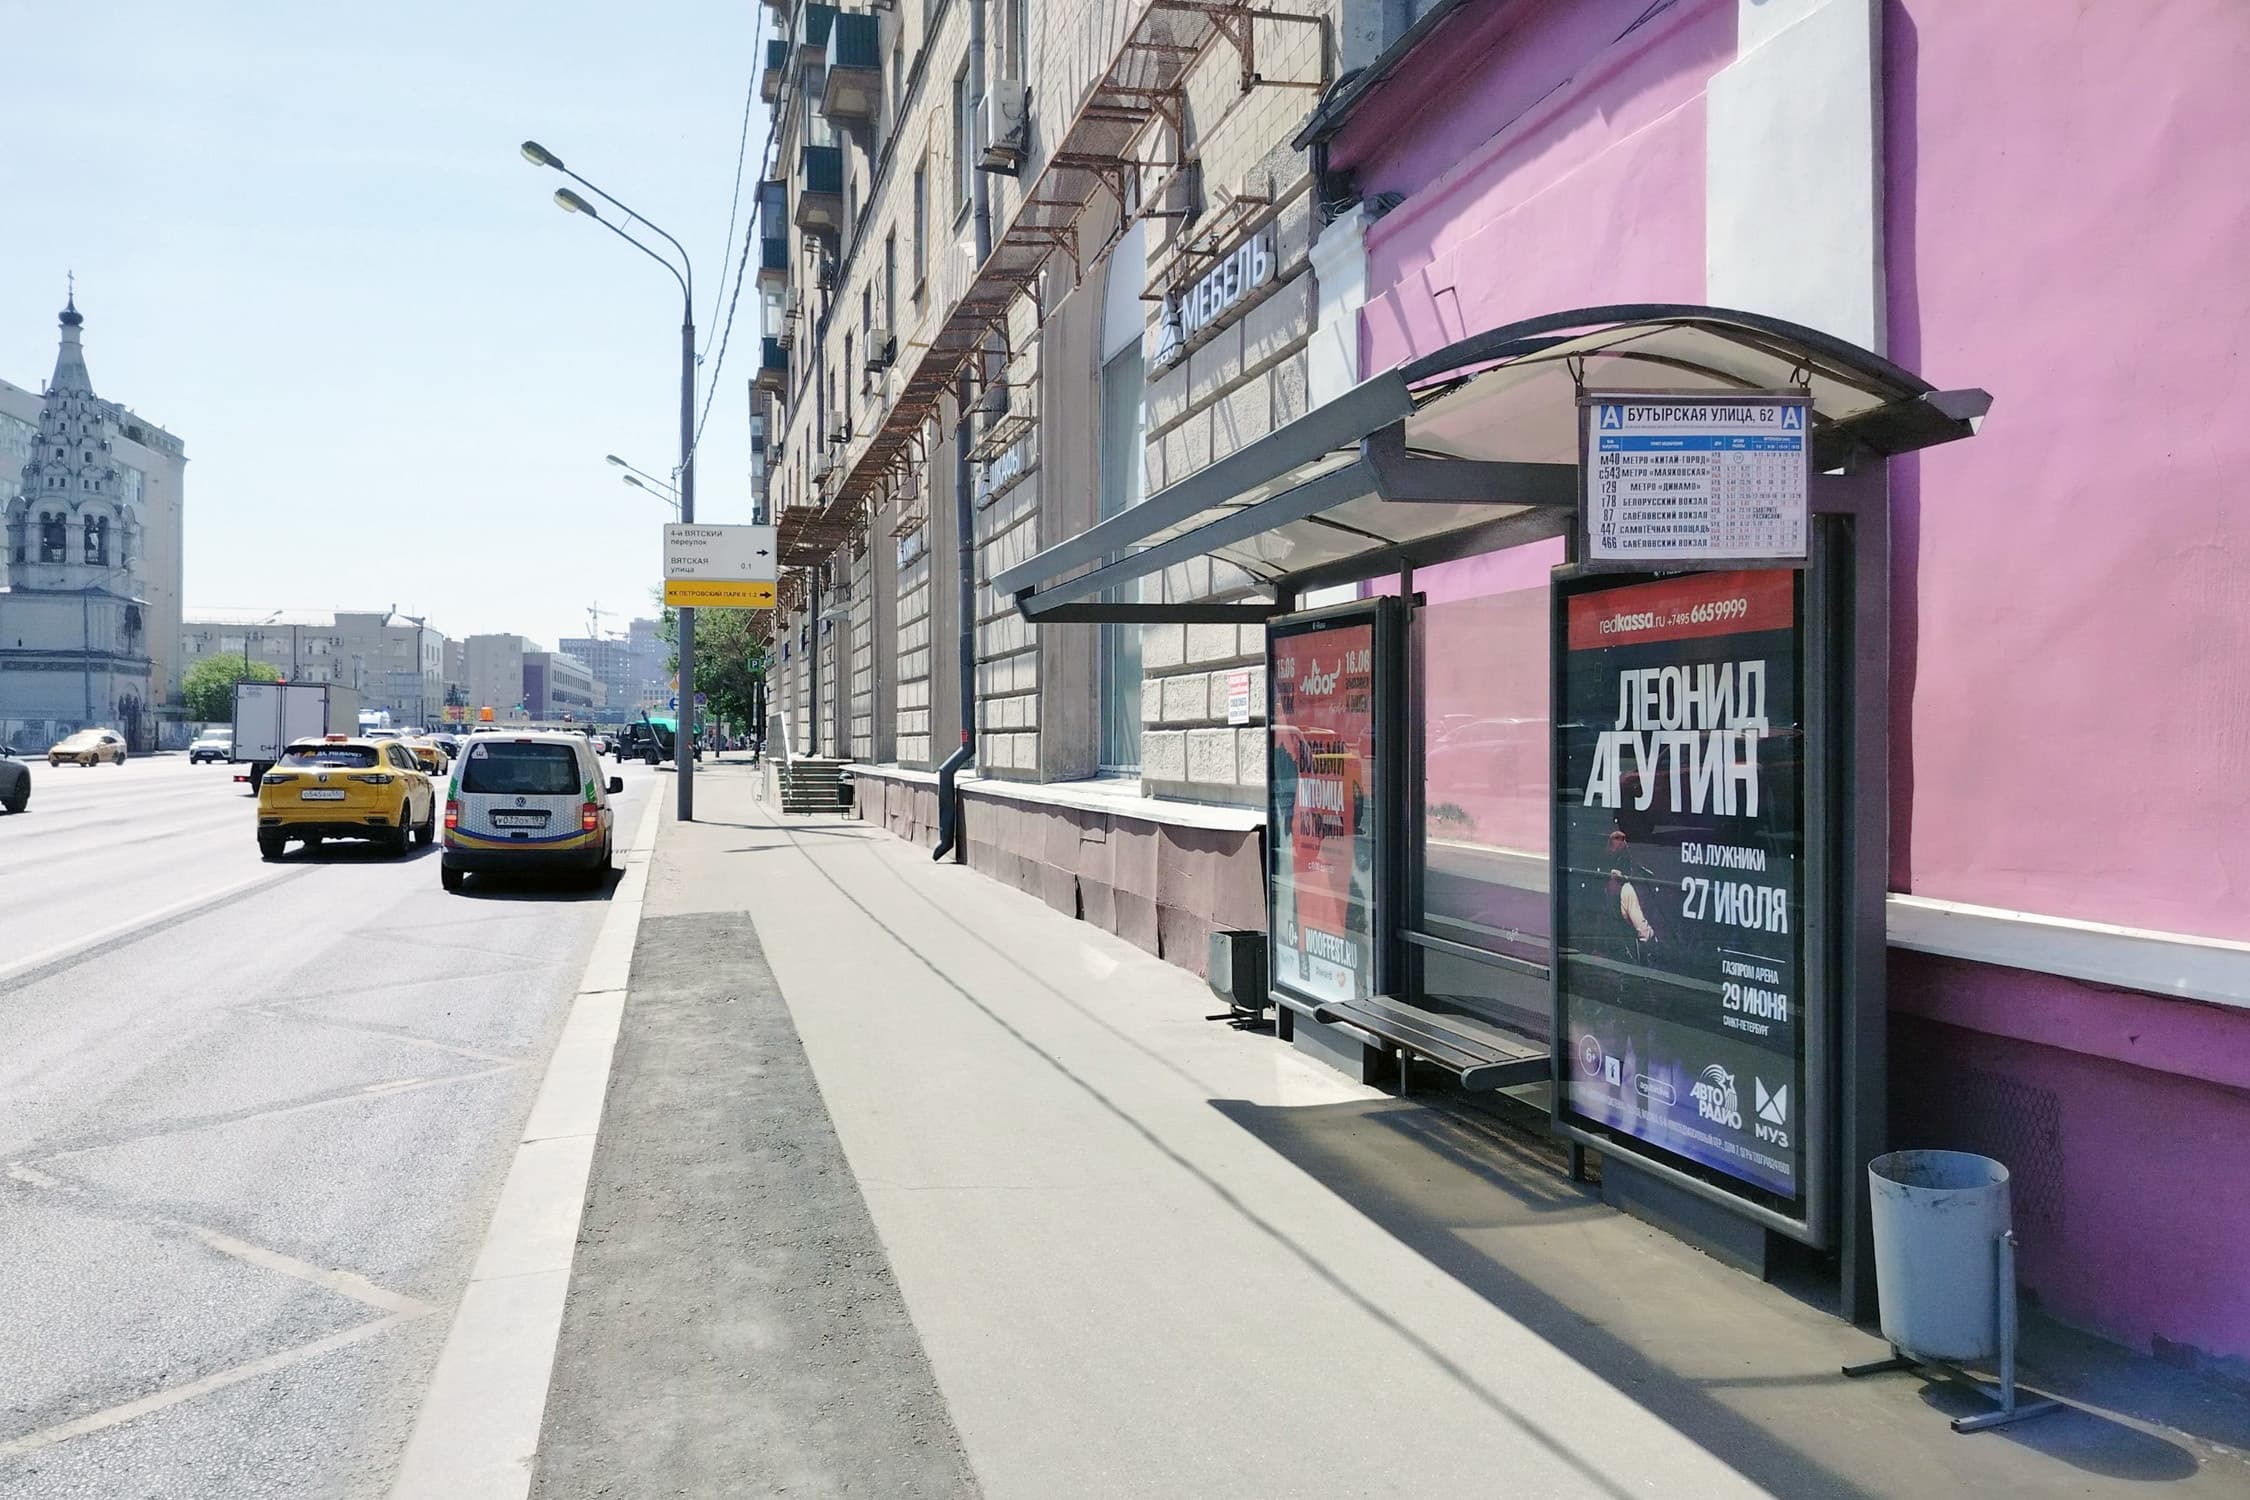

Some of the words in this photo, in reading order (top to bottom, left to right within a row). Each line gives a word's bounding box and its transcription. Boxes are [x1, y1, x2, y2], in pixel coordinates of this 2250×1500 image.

[1183, 234, 1267, 340] МЕБЕЛЬ
[1627, 407, 1707, 422] БУТЫРСКАЯ
[1711, 408, 1756, 424] УЛИЦА,
[1760, 409, 1774, 422] 62
[1622, 456, 1648, 465] МЕТРО
[1622, 469, 1648, 478] МЕТРО
[1630, 483, 1656, 491] МЕТРО
[1623, 497, 1676, 506] БЕЛОРУССКИЙ
[1678, 497, 1708, 505] ВОКЗАЛ
[1603, 509, 1614, 522] 87
[1678, 511, 1708, 519] ВОКЗАЛ
[1600, 523, 1616, 536] 447
[1673, 525, 1710, 534] ПЛОЩАДЬ
[1602, 537, 1617, 549] 466
[1678, 539, 1708, 548] ВОКЗАЛ
[1599, 611, 1665, 634] redkassa.ru
[1667, 613, 1690, 626] +7495
[1690, 598, 1748, 624] 6659999
[1346, 649, 1369, 674] 16.06
[1615, 660, 1769, 738] ЛЕОНИД
[1584, 730, 1759, 817] АГУТИН
[1681, 842, 1703, 865] БСА
[1705, 844, 1766, 872] ЛУЖНИКИ
[1681, 876, 1710, 920] 27
[1714, 881, 1788, 934] ИЮЛЯ
[1288, 922, 1298, 946] 0+
[1305, 927, 1358, 969] WOOFFEST.RU
[1722, 960, 1755, 979] ГАЗПРОМ
[1755, 966, 1779, 985] АРЕНА
[1722, 982, 1740, 1010] 29
[1743, 986, 1787, 1022] ИЮНЯ
[1585, 1047, 1596, 1063] 6+
[1690, 1081, 1723, 1106] АВТО
[1699, 1100, 1742, 1130] РАДИО
[1755, 1122, 1789, 1148] МУЗ
